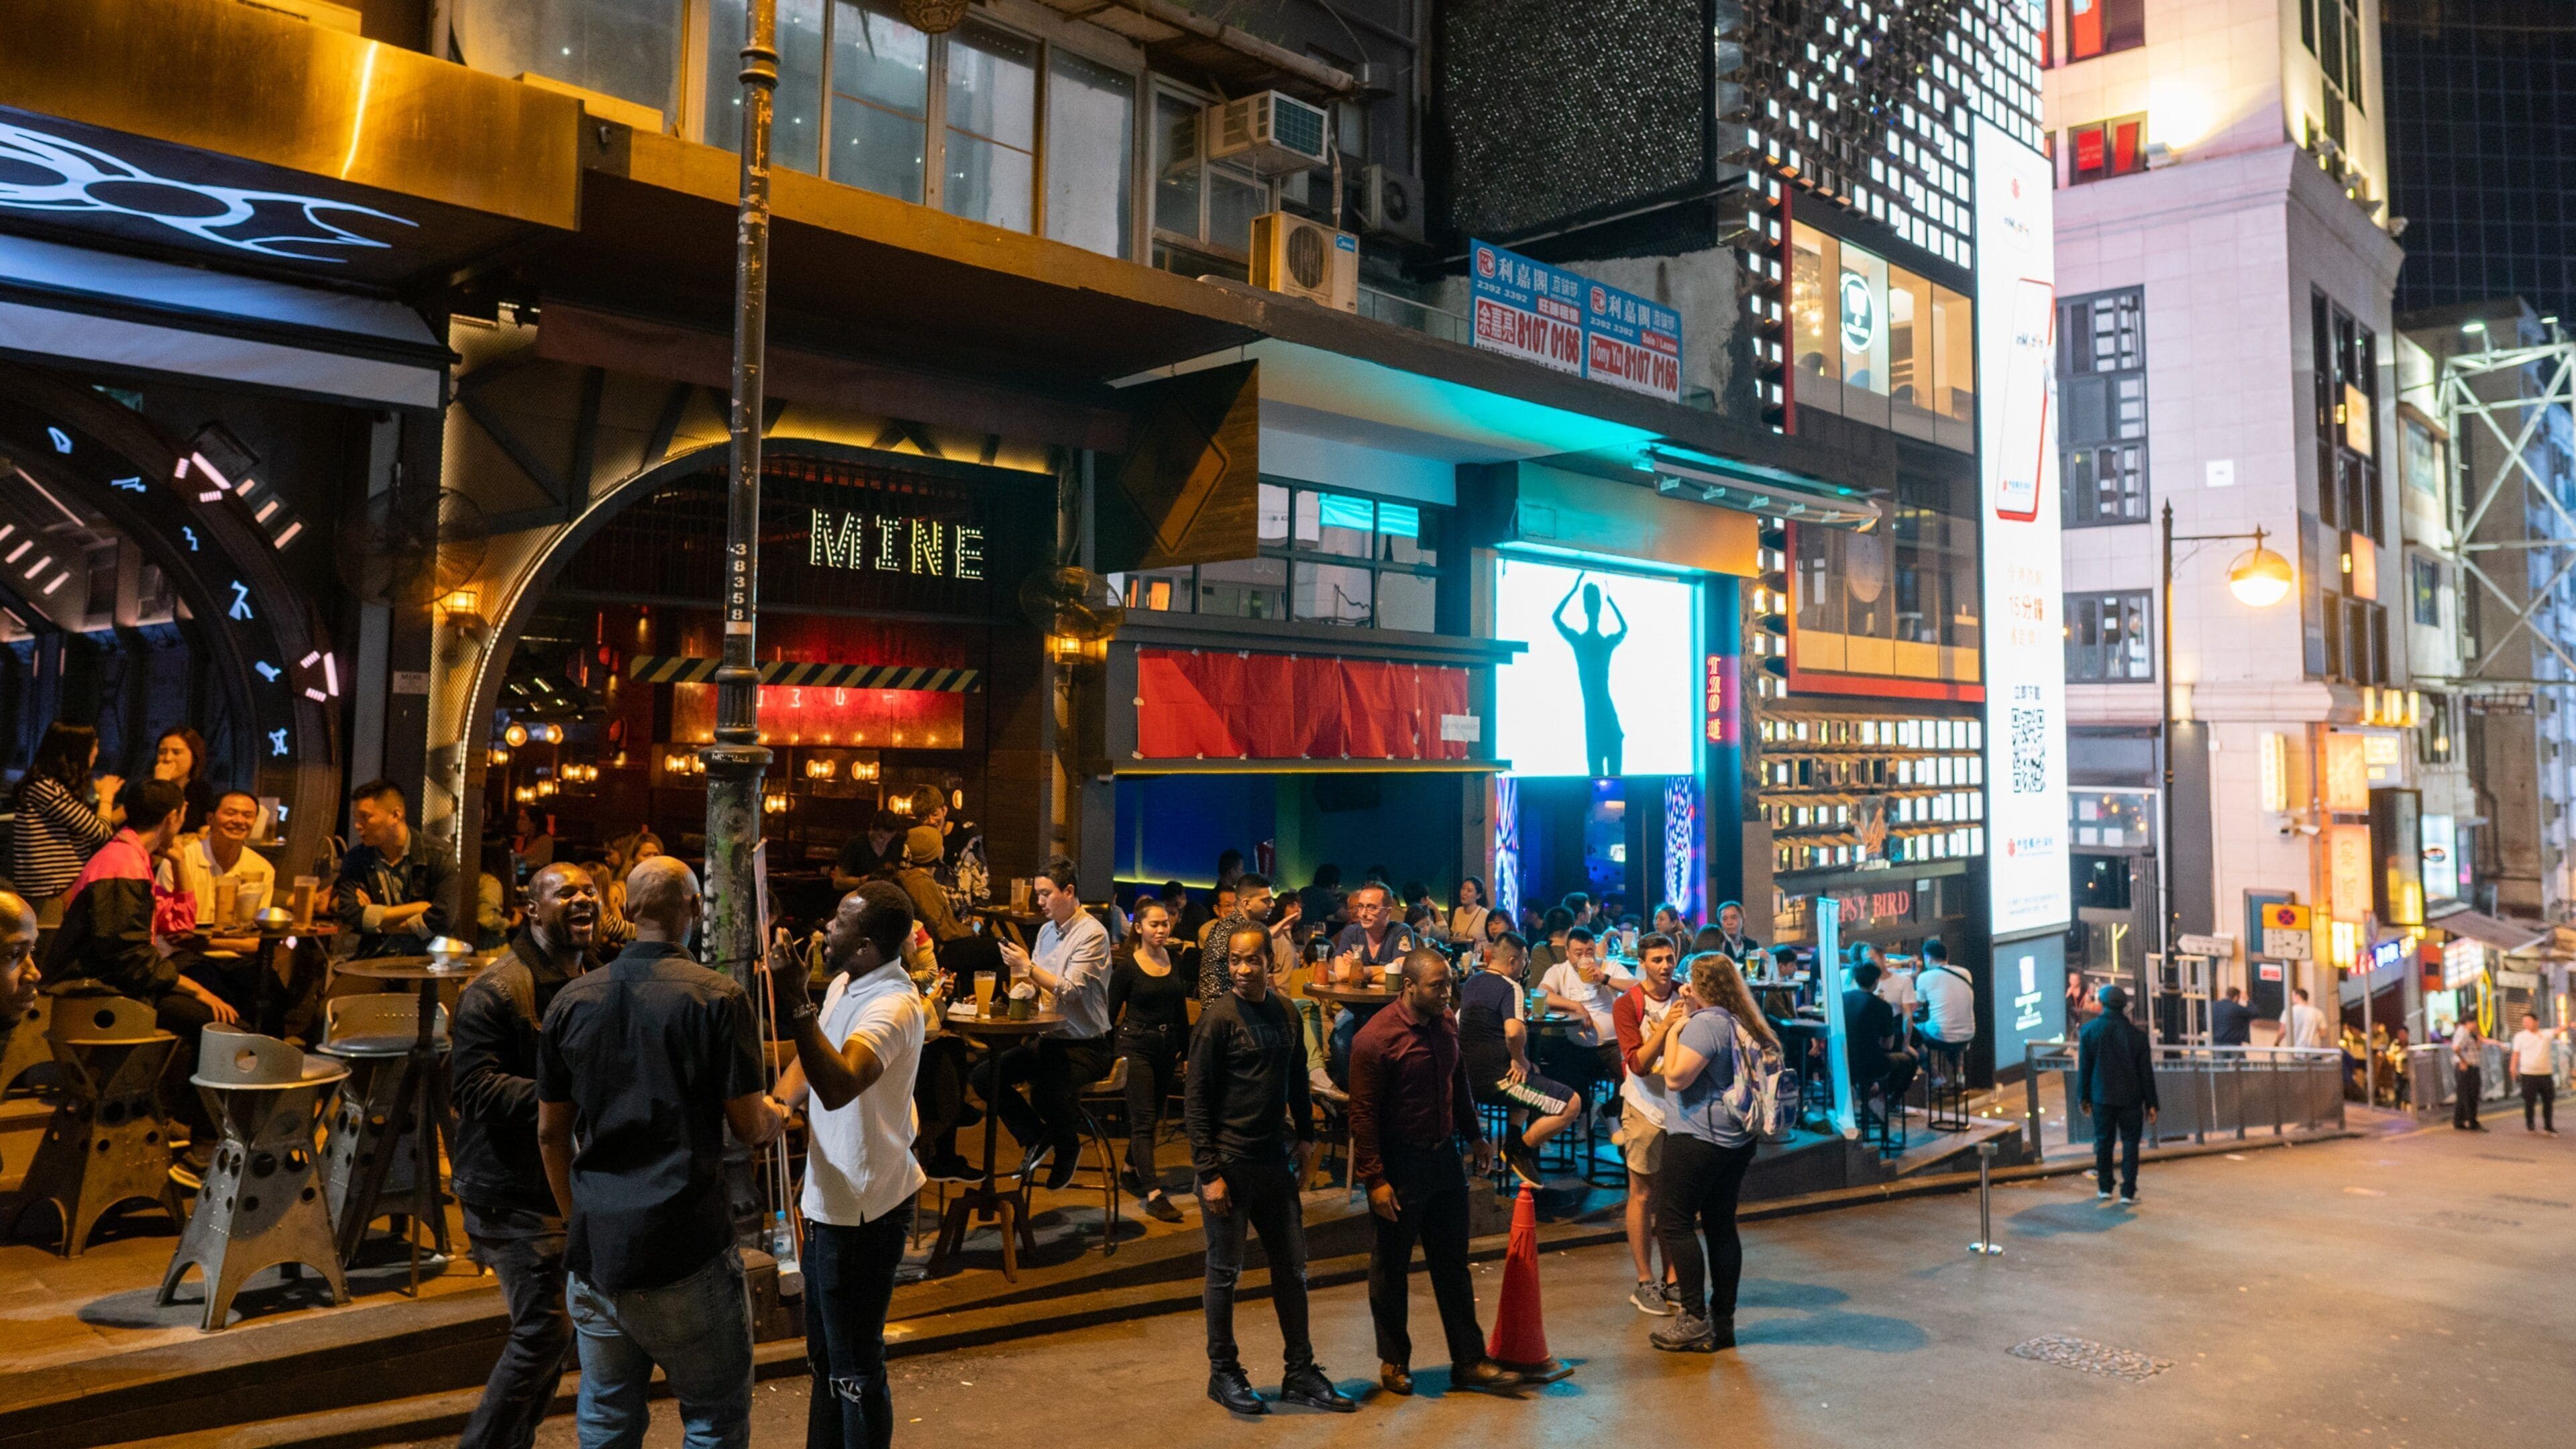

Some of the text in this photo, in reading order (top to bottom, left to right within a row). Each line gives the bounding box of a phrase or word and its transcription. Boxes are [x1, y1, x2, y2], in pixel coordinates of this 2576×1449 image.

[1477, 280, 1528, 303] 2392 3392
[1517, 312, 1548, 355] 8107
[1551, 322, 1580, 366] 0166
[1591, 317, 1611, 330] 2392
[1591, 339, 1610, 368] Tony
[1611, 345, 1622, 367] Yu
[1624, 345, 1650, 385] 8107
[1653, 355, 1678, 393] 0166
[810, 508, 984, 580] MINE
[732, 543, 747, 621] 38358
[1839, 891, 1911, 923] PSY BIRD
